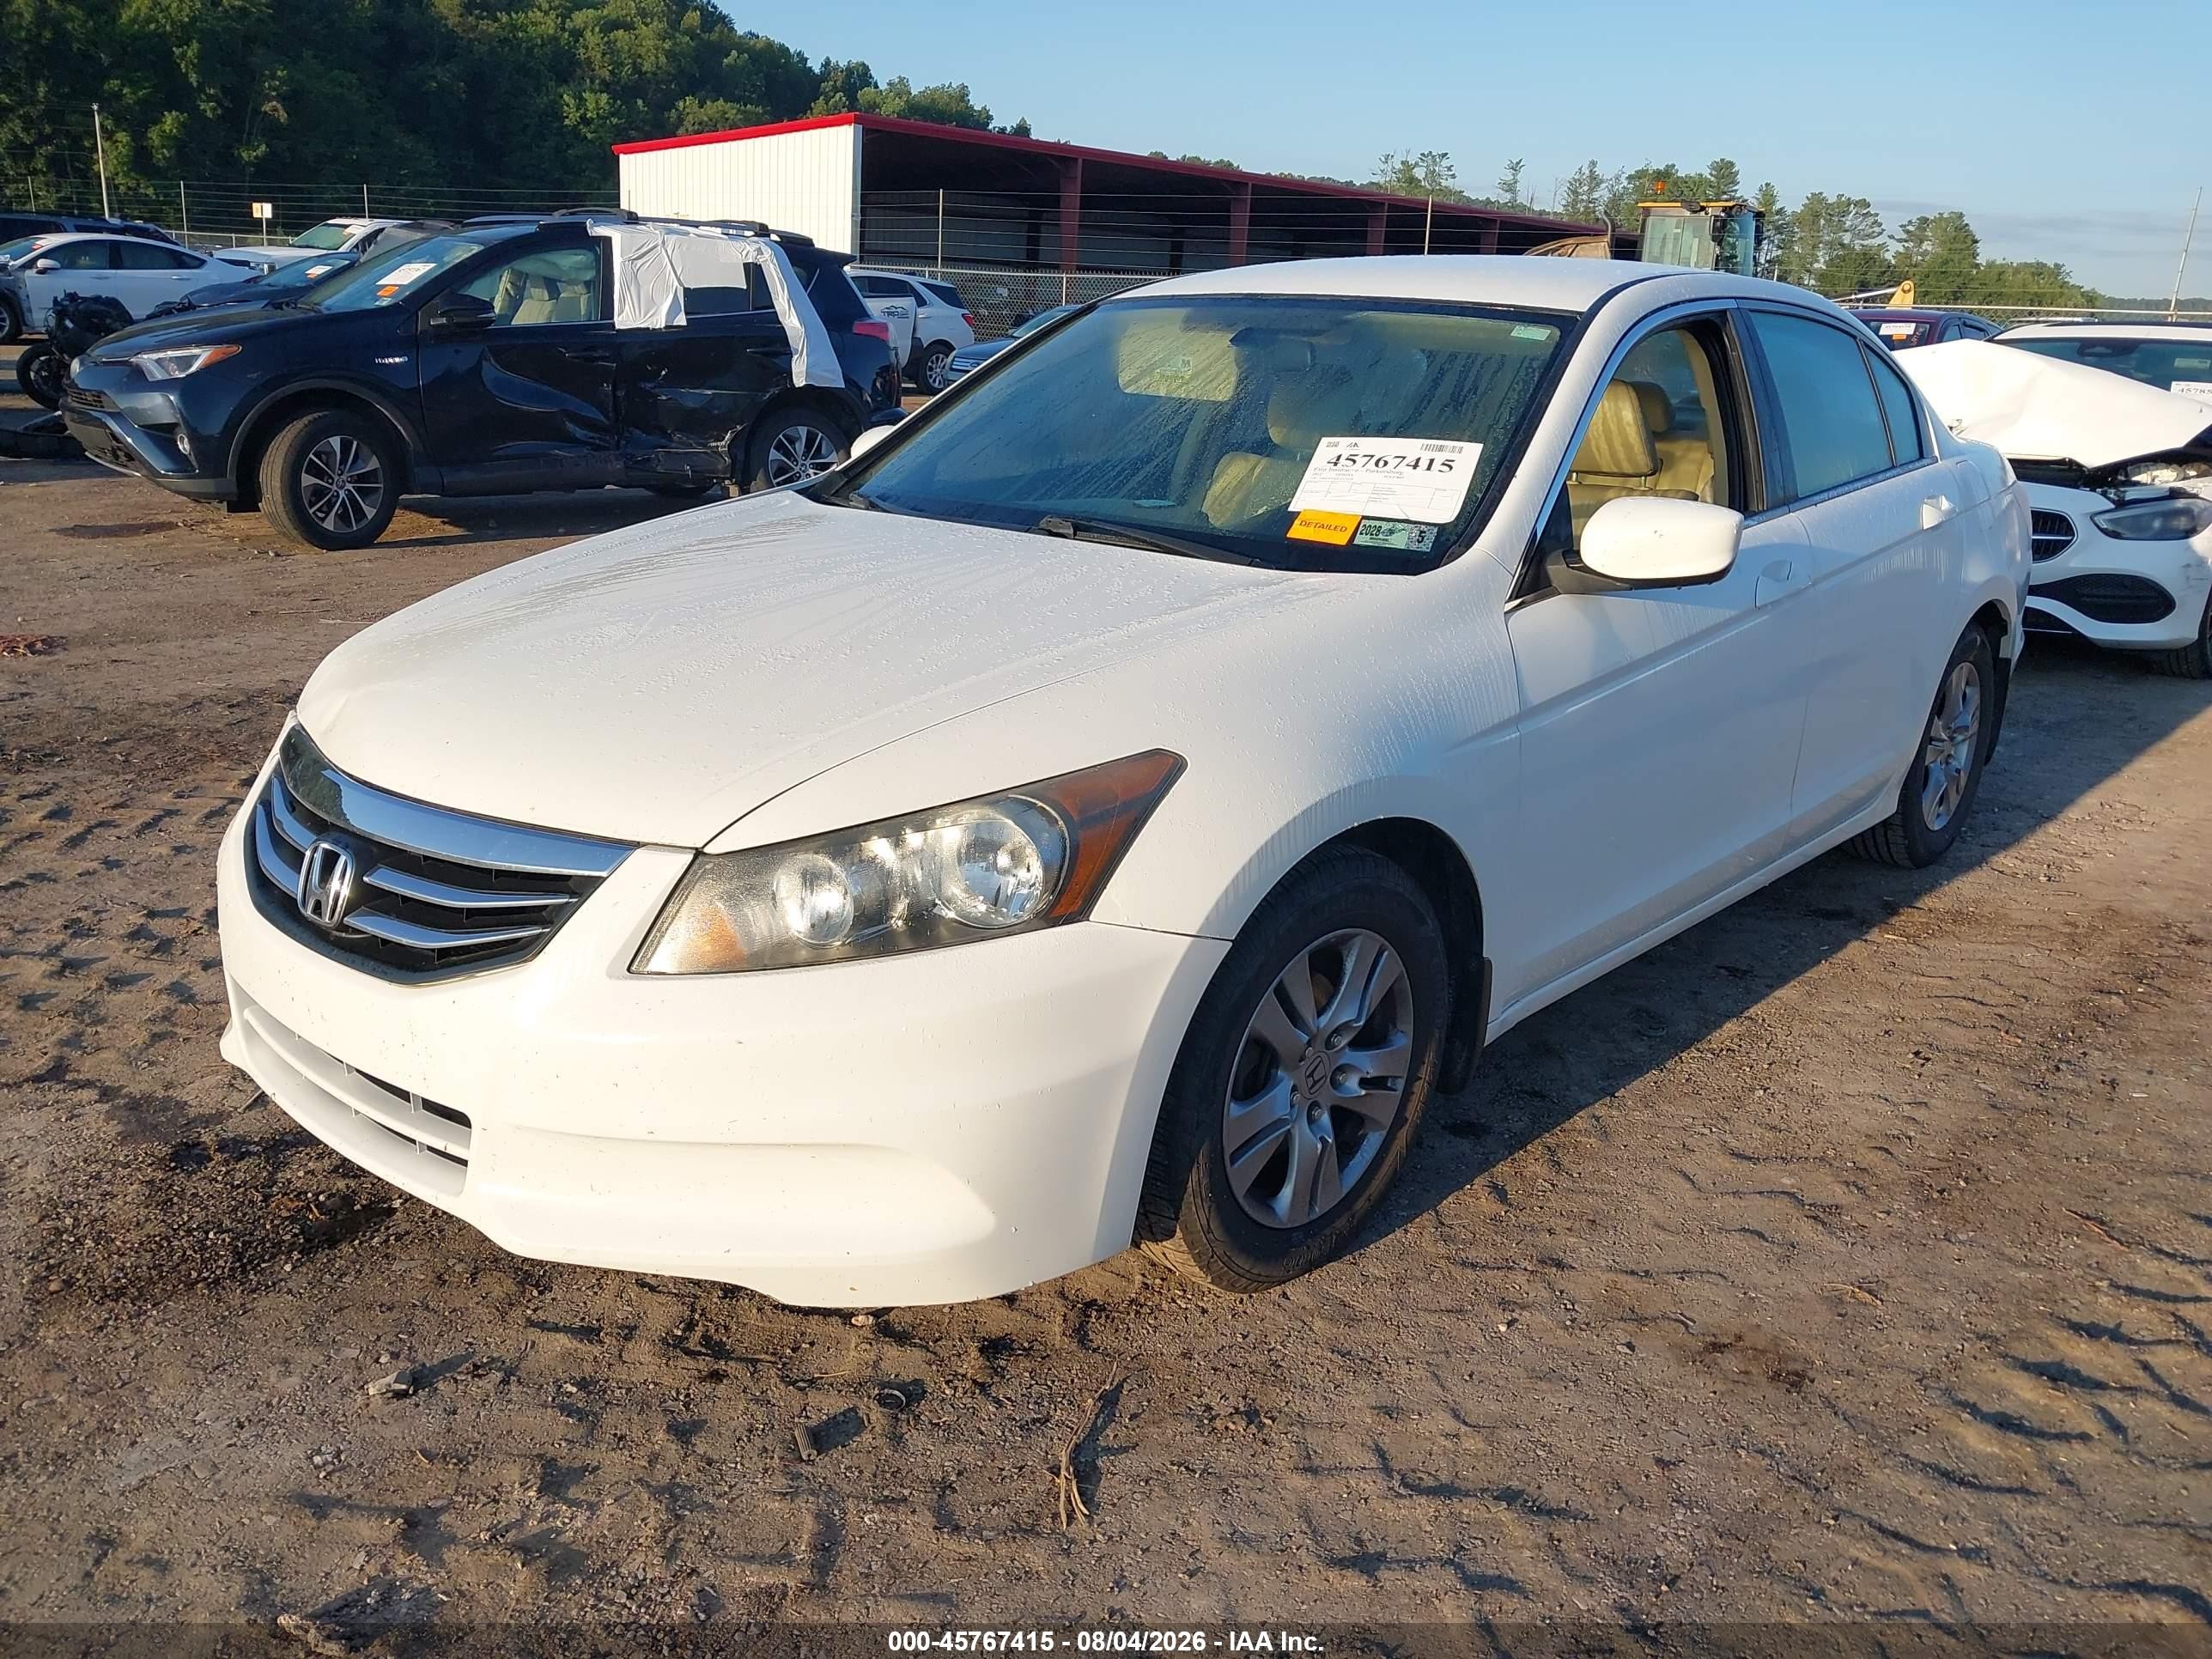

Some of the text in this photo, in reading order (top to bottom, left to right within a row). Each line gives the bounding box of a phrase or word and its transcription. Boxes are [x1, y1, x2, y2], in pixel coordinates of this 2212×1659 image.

[1327, 453, 1456, 473] 45767415
[1299, 520, 1348, 533] DETAILED
[1358, 524, 1382, 538] 2028
[1416, 530, 1426, 544] 5
